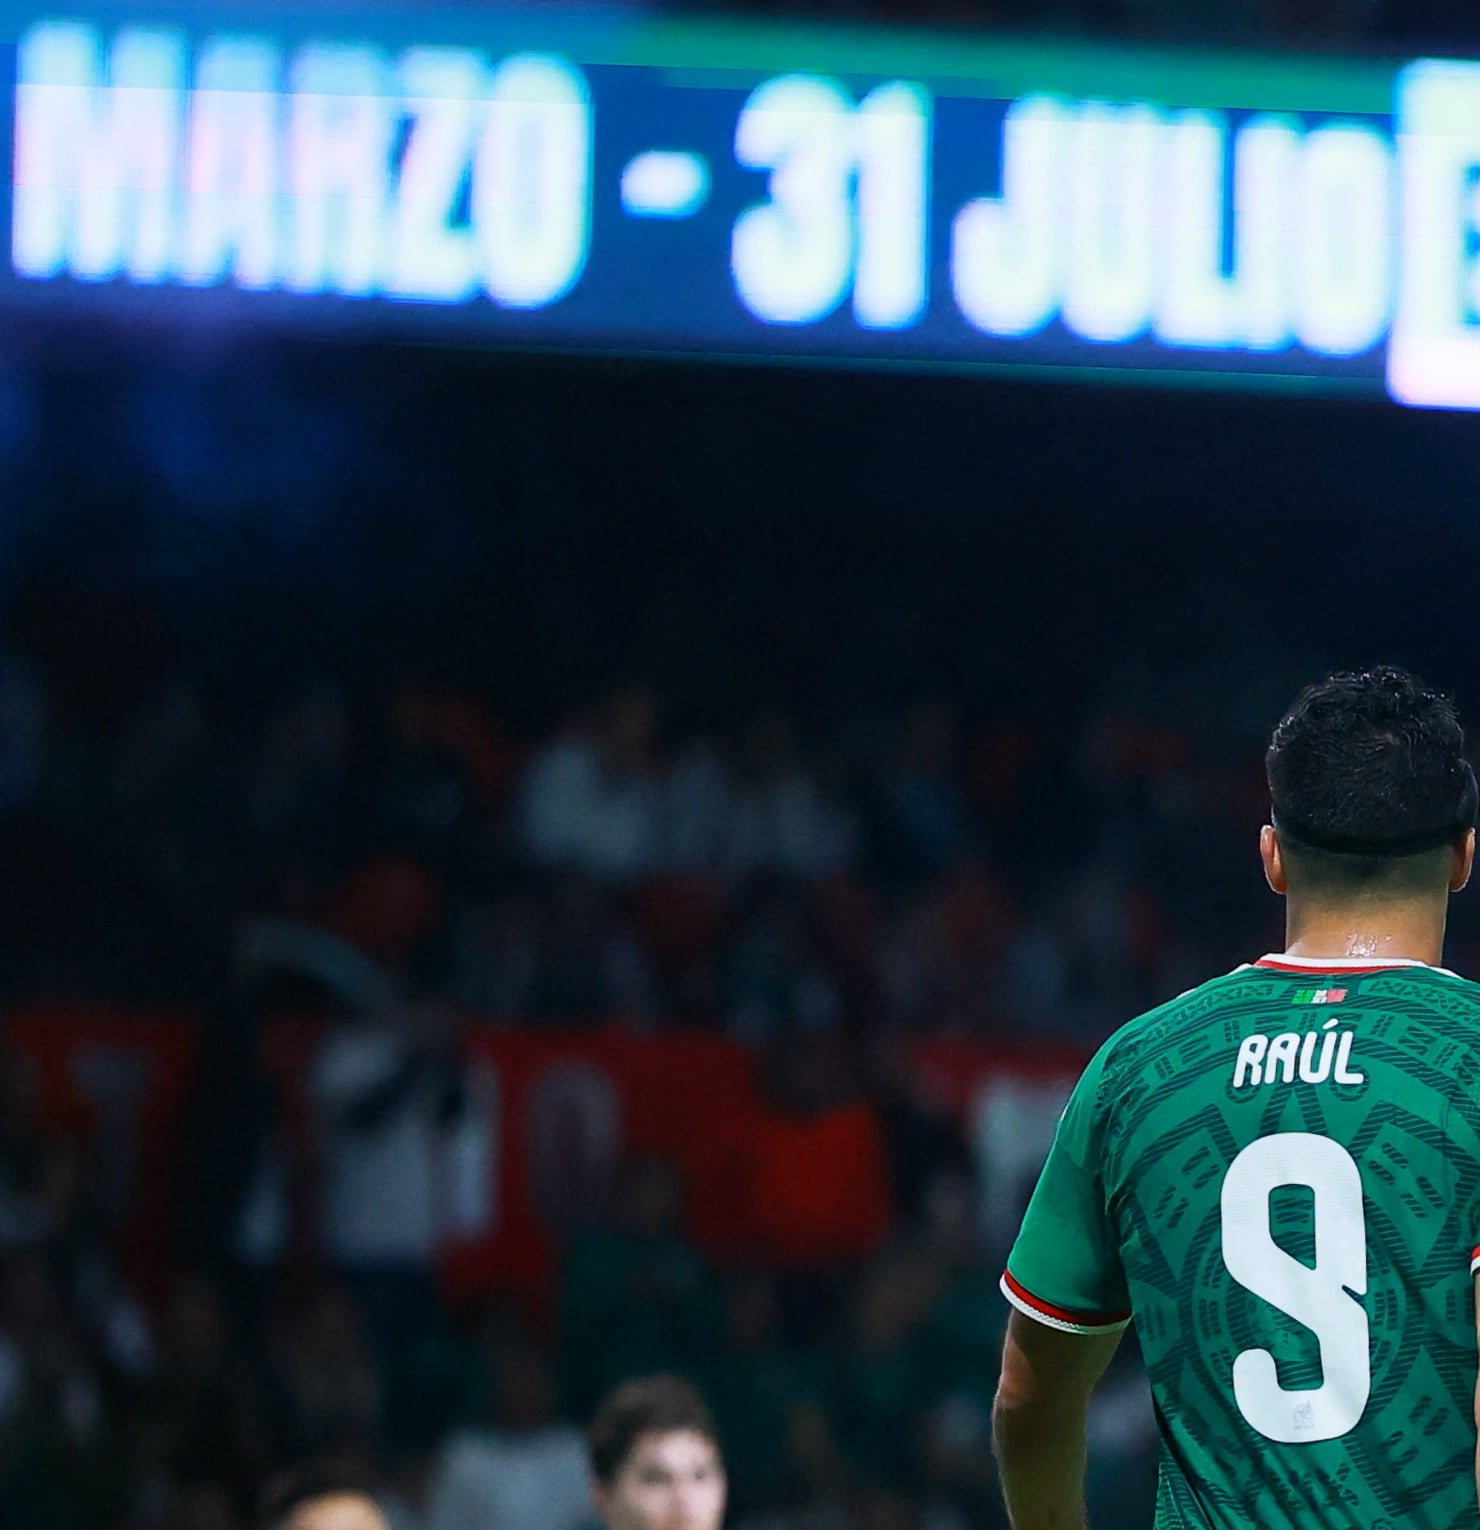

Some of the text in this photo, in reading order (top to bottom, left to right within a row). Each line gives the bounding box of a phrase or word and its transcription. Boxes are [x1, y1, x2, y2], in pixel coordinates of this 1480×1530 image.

[12, 19, 592, 310] MARZO
[732, 73, 932, 329] 31
[952, 91, 1397, 357] JULIO
[1232, 1018, 1365, 1089] RAÚL
[1220, 1131, 1372, 1444] 9
